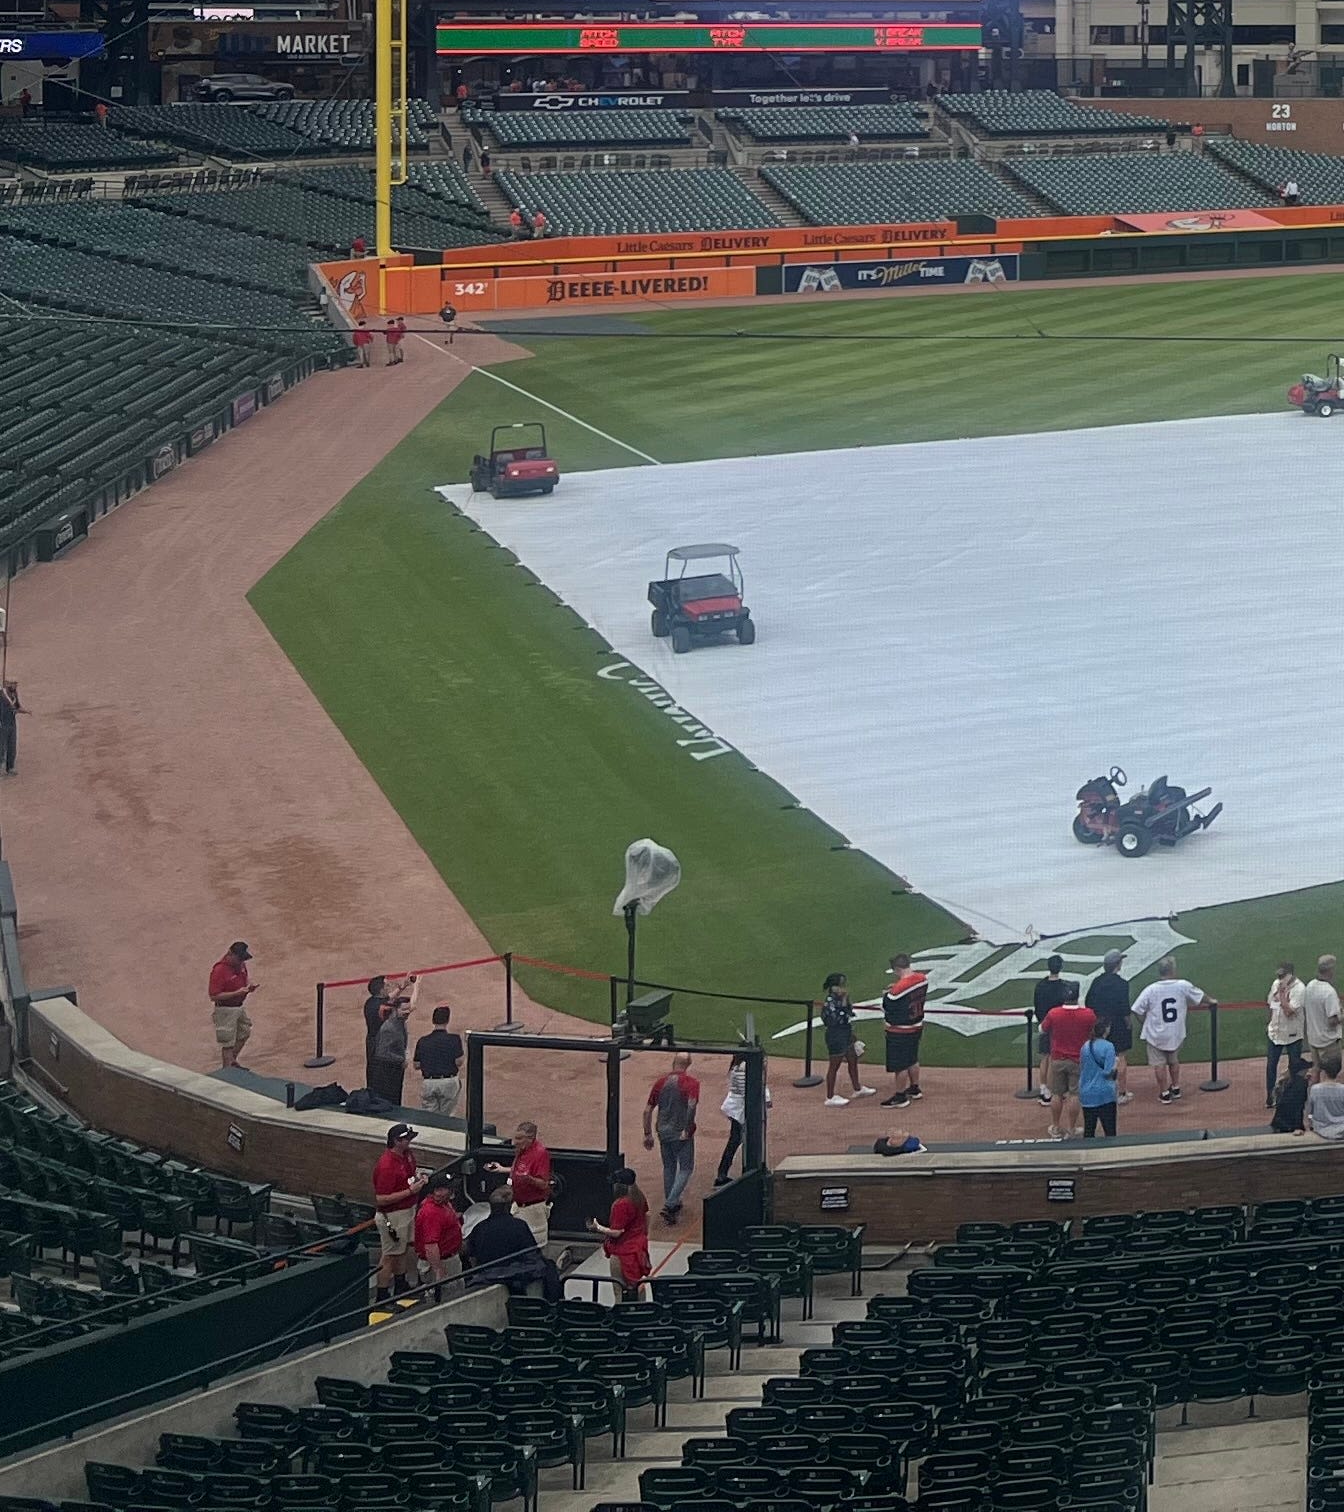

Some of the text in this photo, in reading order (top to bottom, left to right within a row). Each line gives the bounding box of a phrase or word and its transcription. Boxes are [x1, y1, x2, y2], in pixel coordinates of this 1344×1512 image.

[277, 34, 351, 54] MARKET
[1271, 104, 1291, 119] 23
[616, 239, 650, 253] Little
[651, 238, 695, 252] Caesars
[919, 265, 945, 278] TIME
[1160, 998, 1178, 1023] 6
